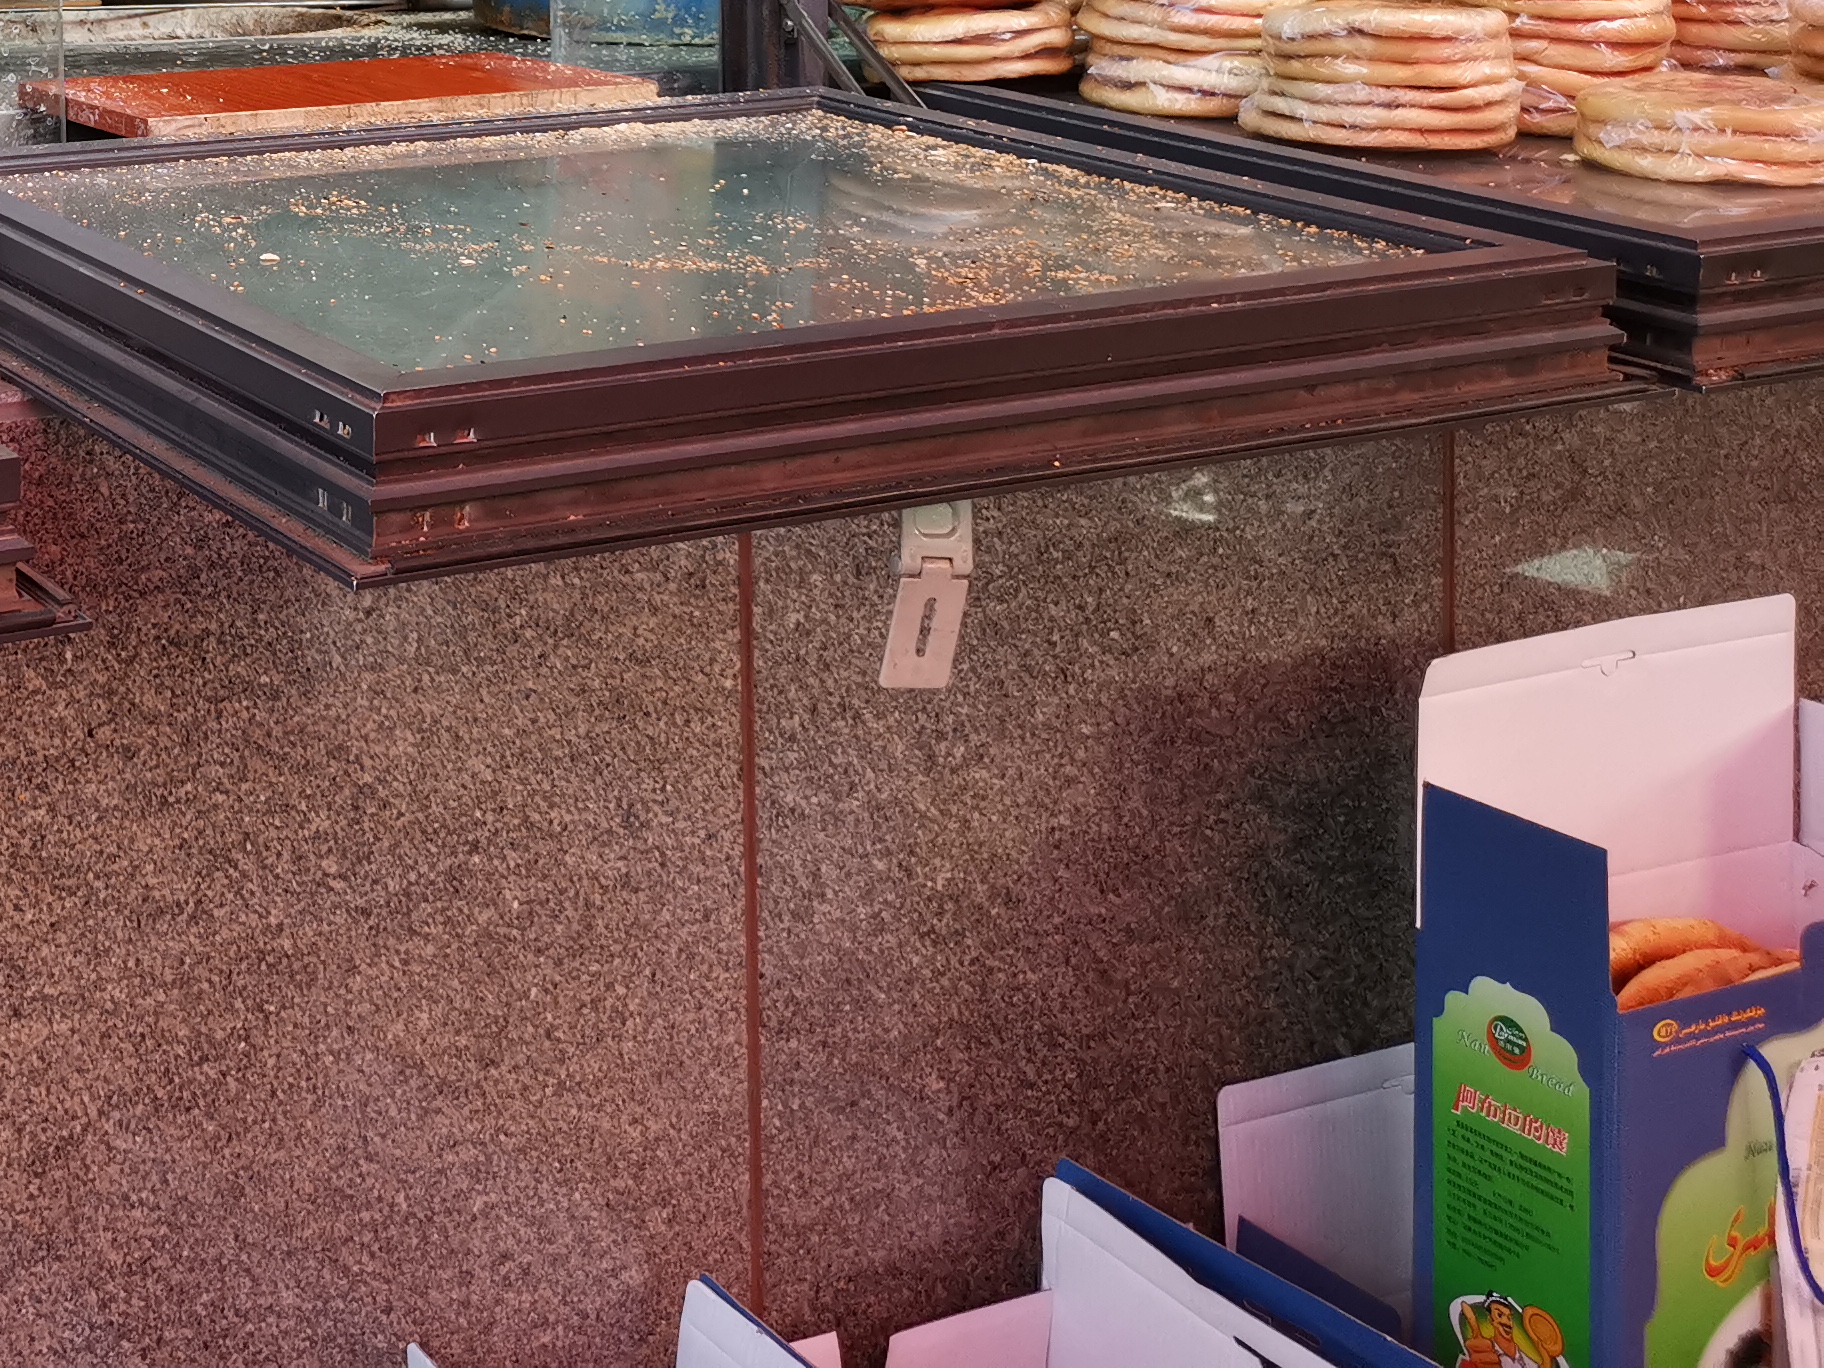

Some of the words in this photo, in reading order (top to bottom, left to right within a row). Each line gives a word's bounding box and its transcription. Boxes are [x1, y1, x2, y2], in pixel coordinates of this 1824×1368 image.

[1456, 1029, 1491, 1056] Nan
[1528, 1065, 1576, 1097] Bread
[1451, 1083, 1570, 1157] 阿布拉的馕
